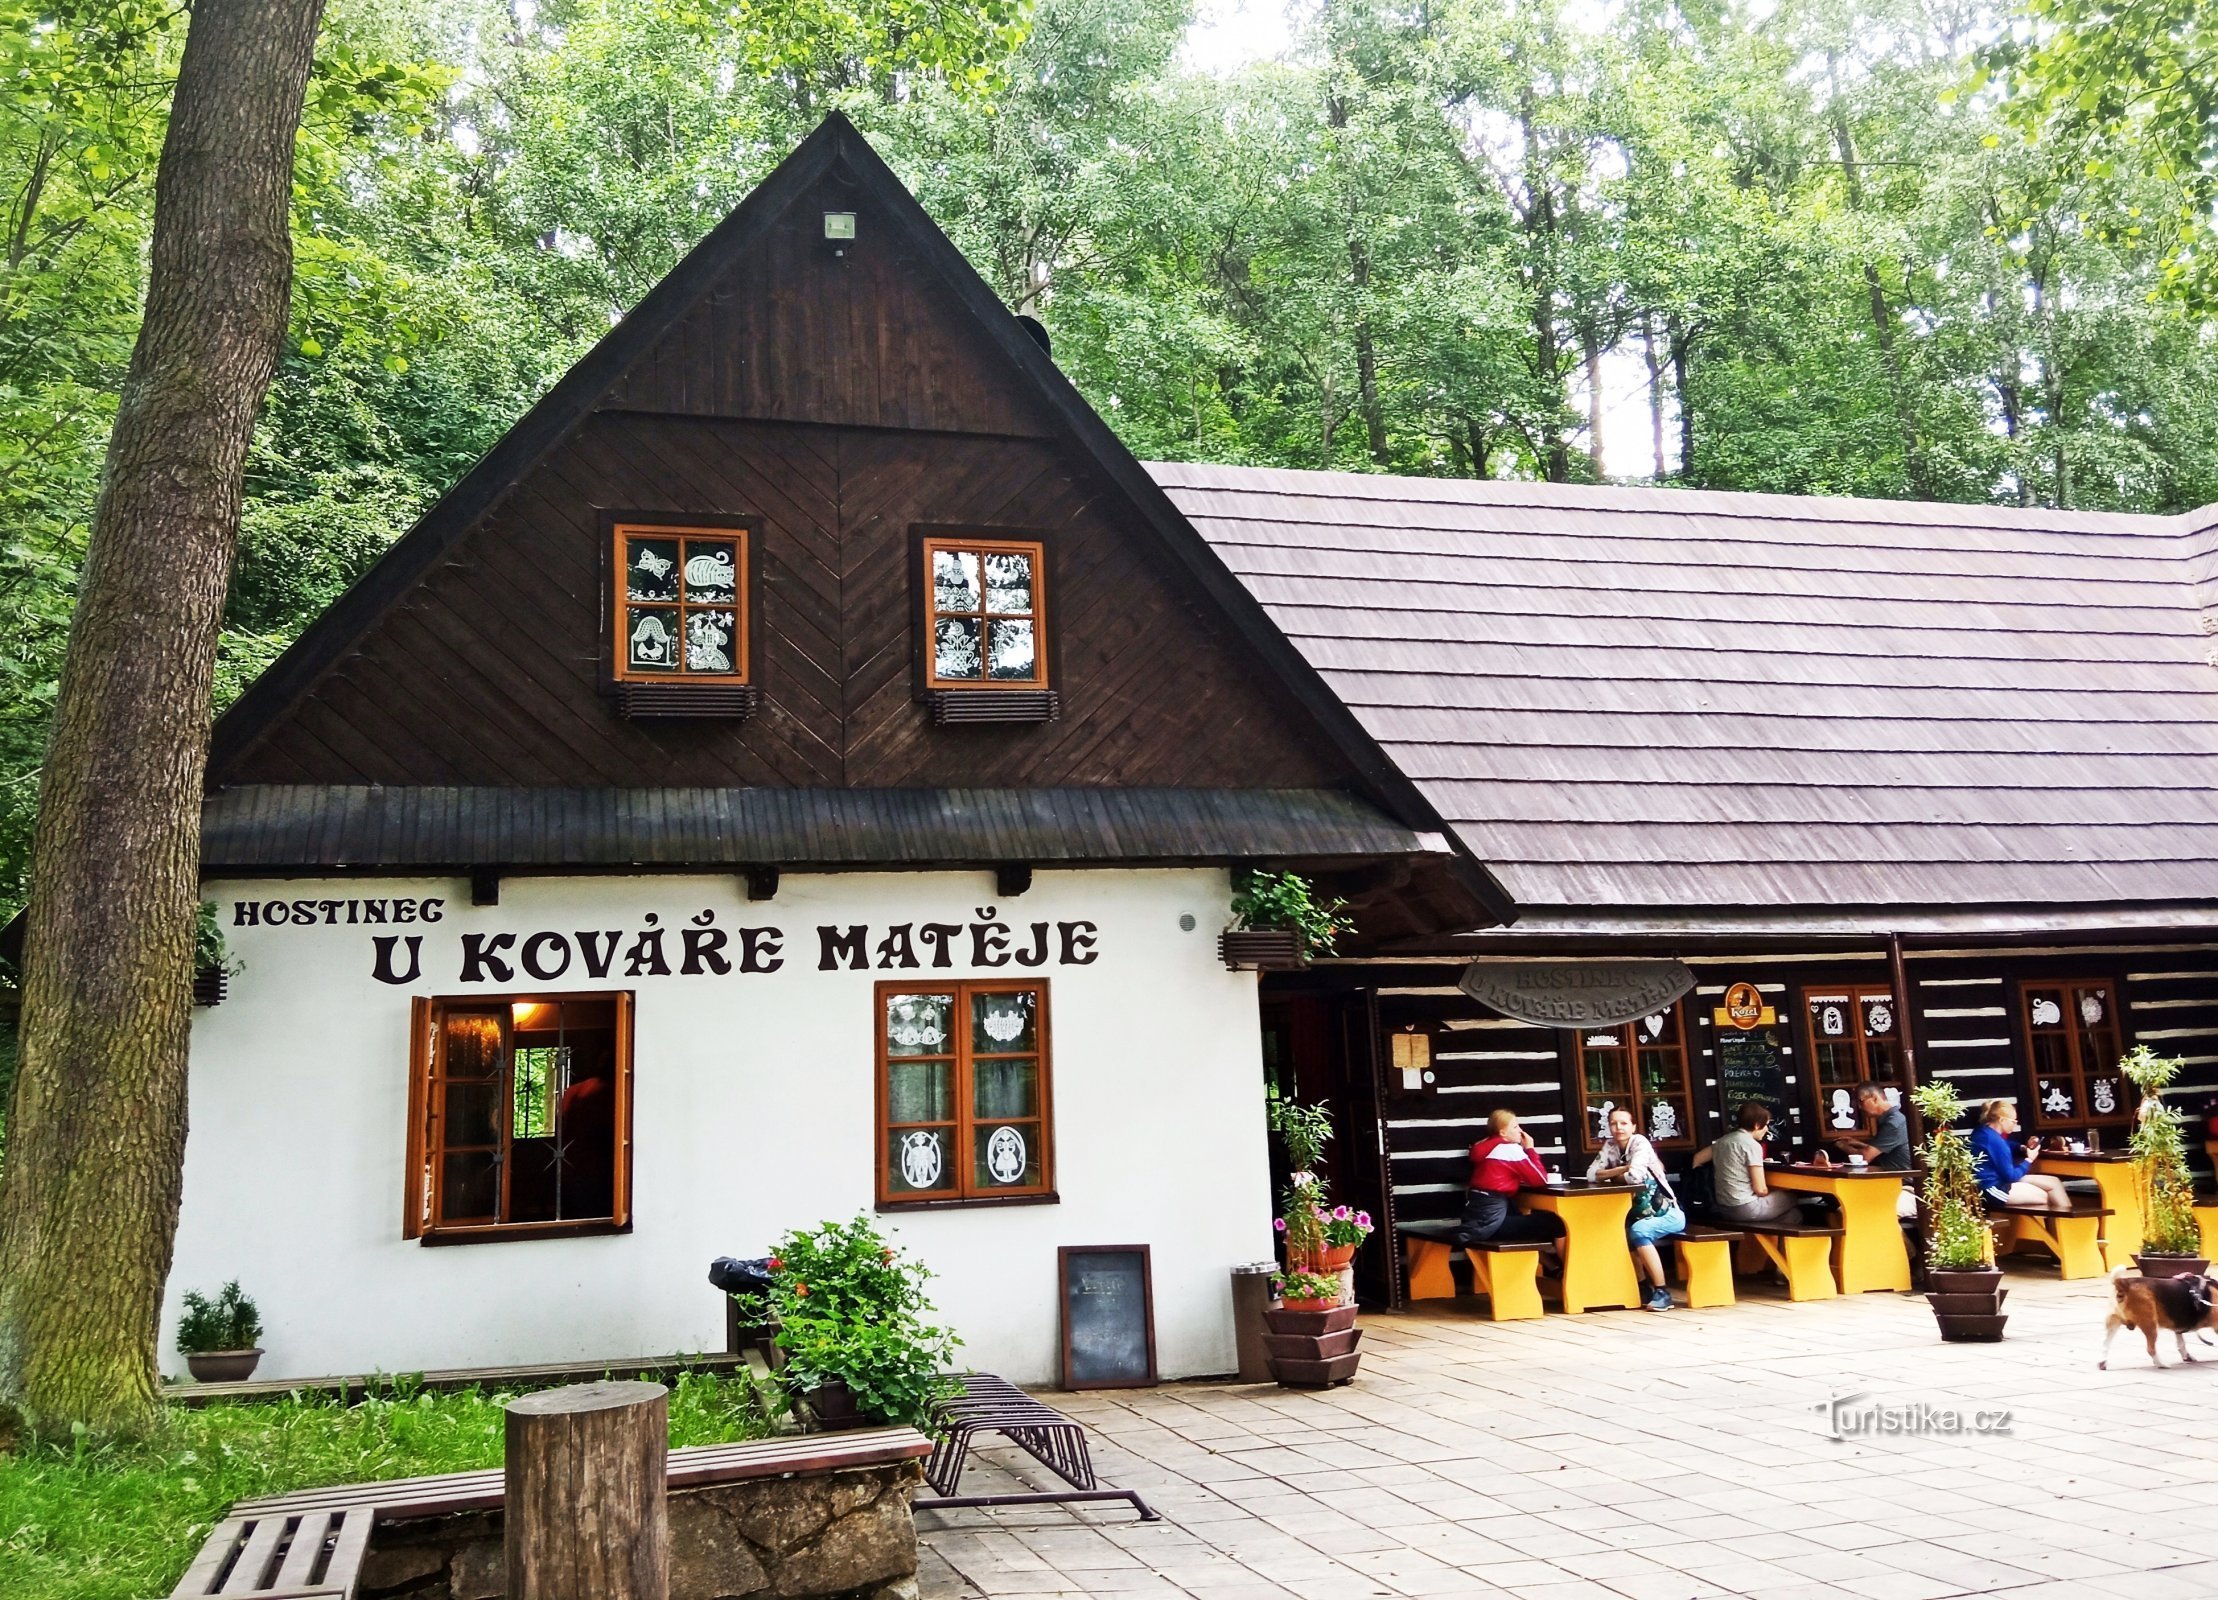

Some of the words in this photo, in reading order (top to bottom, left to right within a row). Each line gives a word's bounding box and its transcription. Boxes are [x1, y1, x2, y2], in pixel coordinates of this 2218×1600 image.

[233, 898, 445, 926] HOSTINEC
[372, 935, 423, 985] U
[459, 909, 785, 983] KOVÁŘE
[816, 906, 1099, 971] MATĚJE
[1469, 969, 1485, 993] U
[1516, 967, 1640, 989] HOSTINEC
[1731, 1007, 1759, 1018] Kozel
